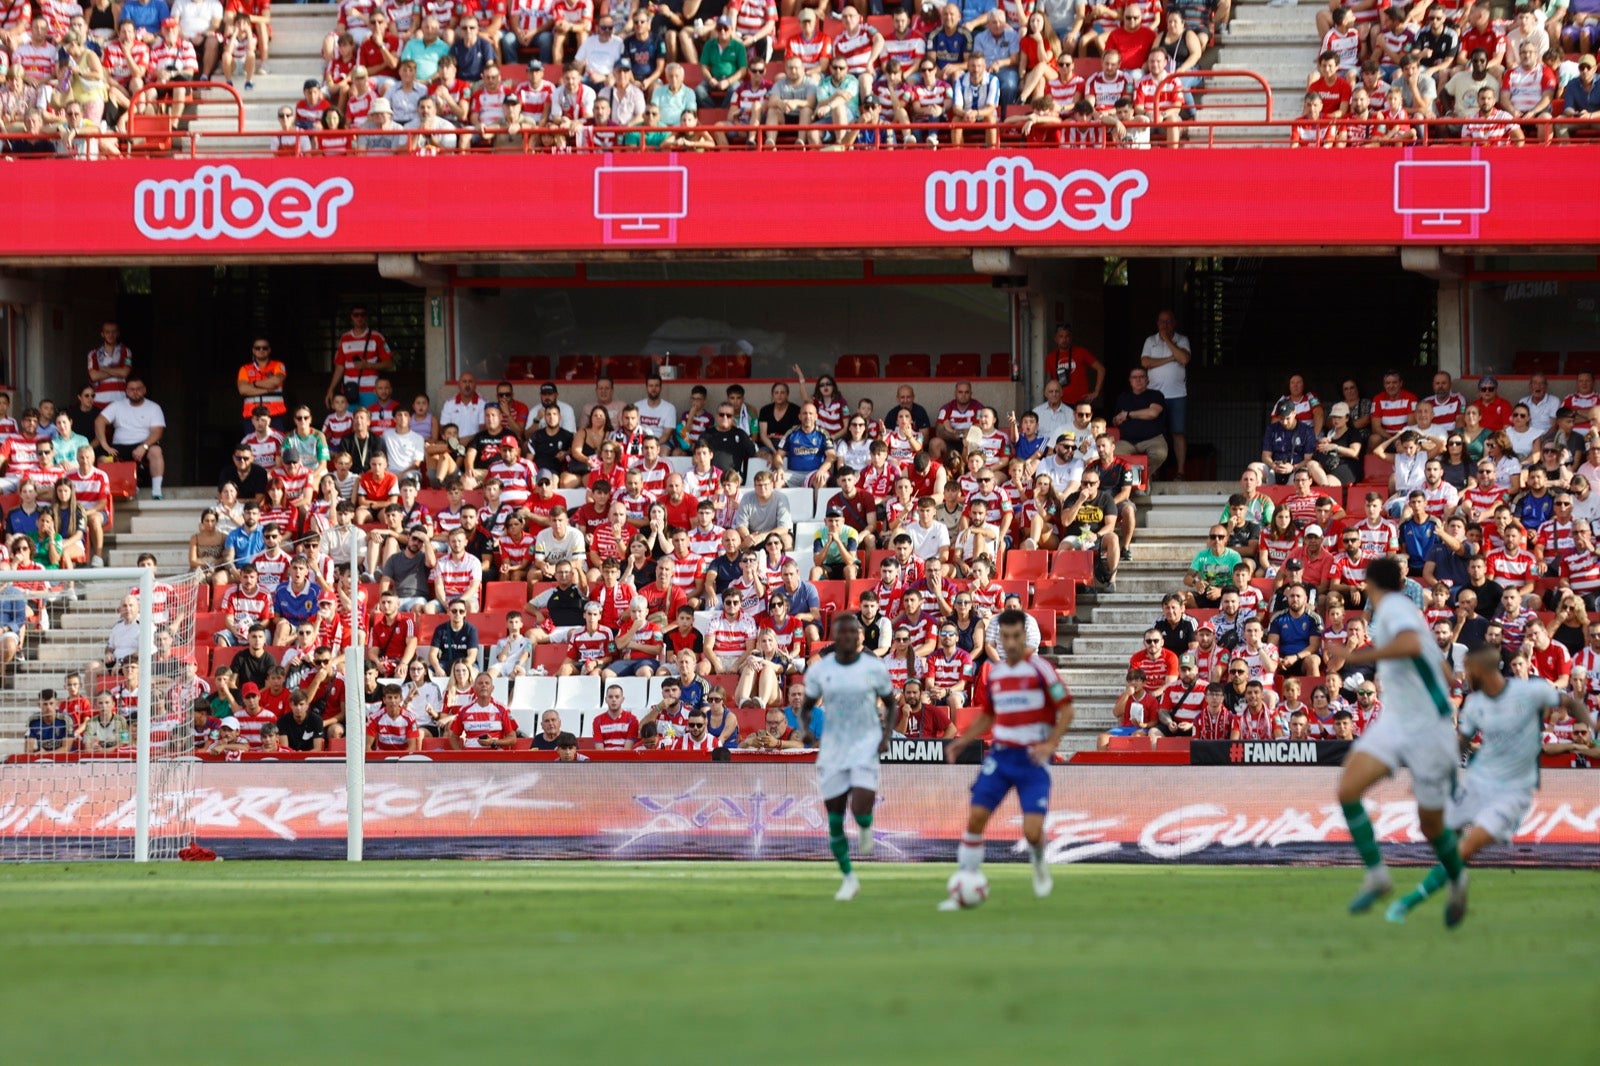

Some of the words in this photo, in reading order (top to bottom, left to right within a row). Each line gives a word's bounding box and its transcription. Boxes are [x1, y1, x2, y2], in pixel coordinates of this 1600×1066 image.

[133, 164, 354, 240] wiber
[925, 156, 1149, 231] wiber
[880, 740, 944, 761] ANCAM
[1229, 742, 1318, 763] #FANCAM
